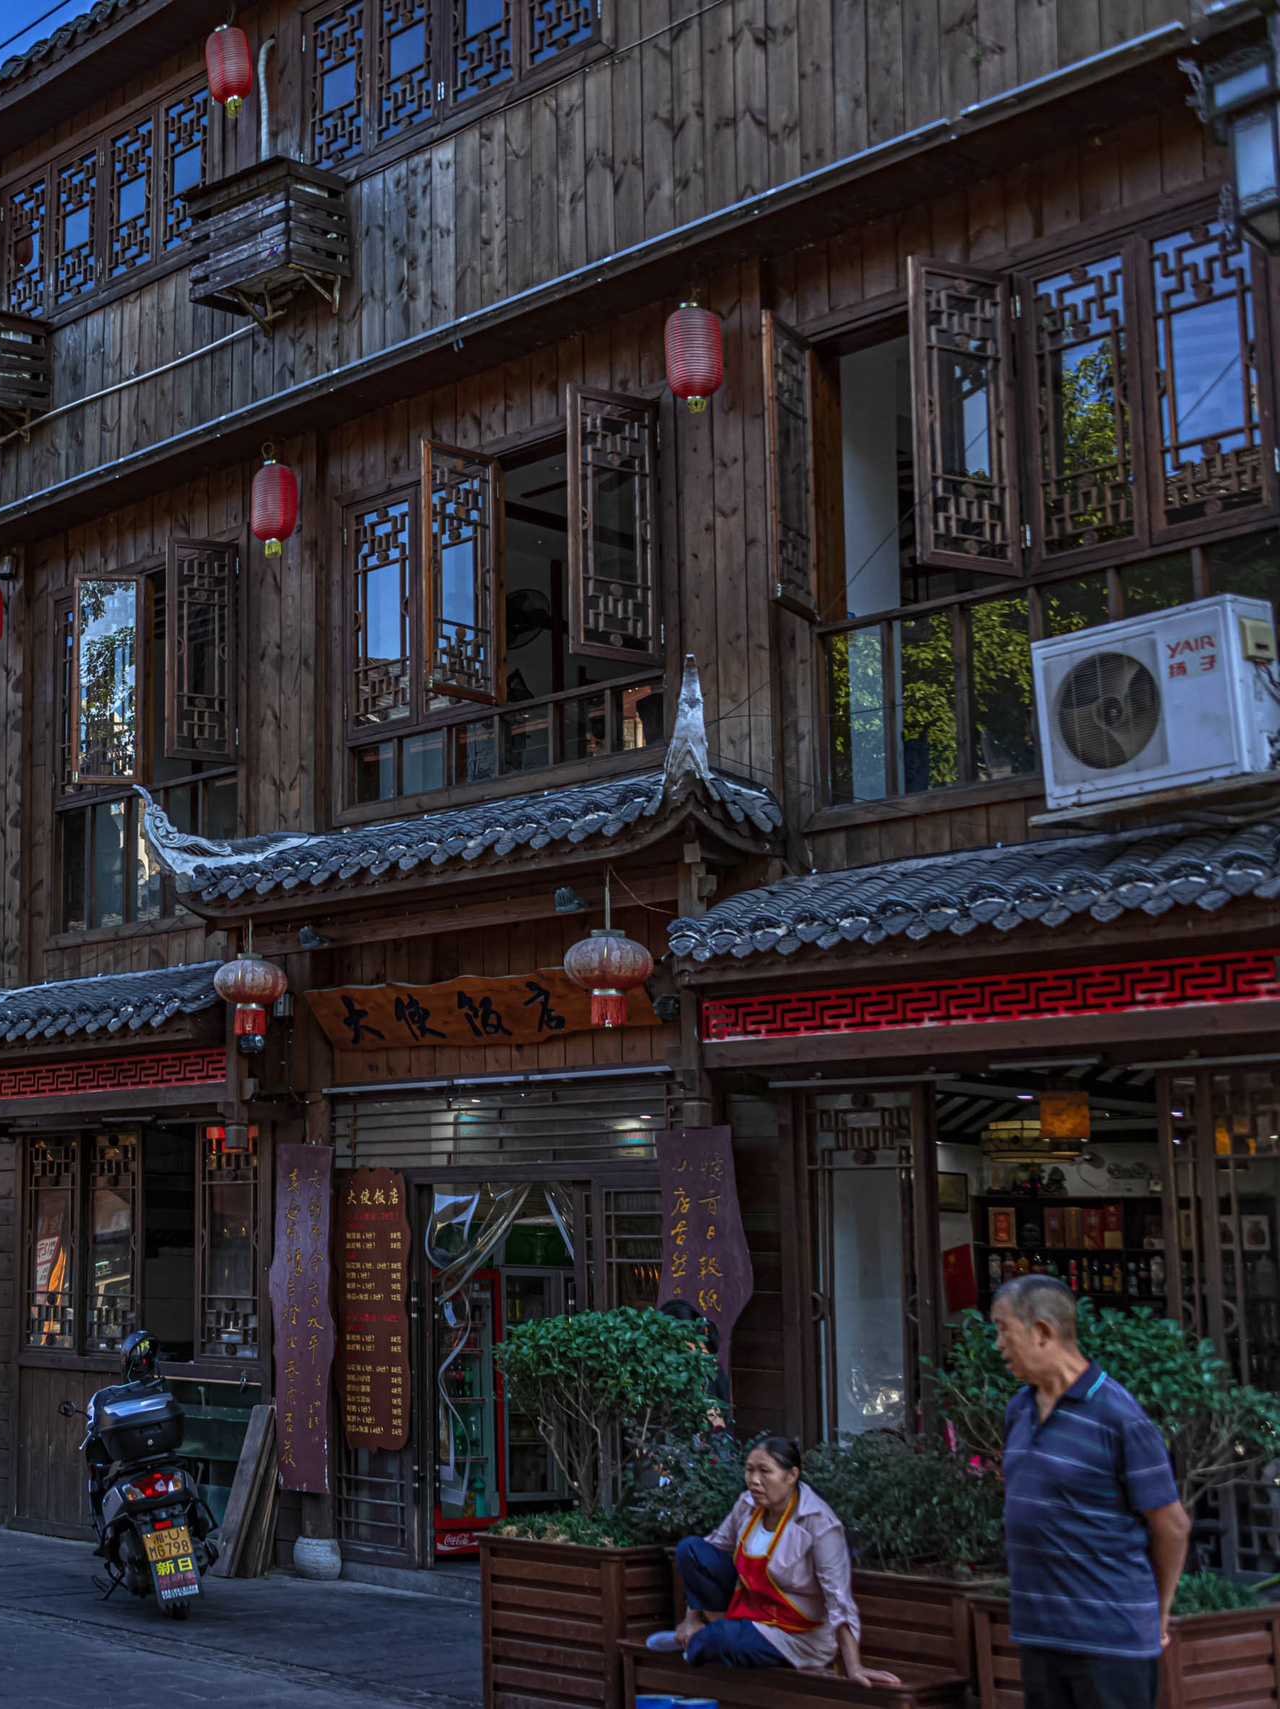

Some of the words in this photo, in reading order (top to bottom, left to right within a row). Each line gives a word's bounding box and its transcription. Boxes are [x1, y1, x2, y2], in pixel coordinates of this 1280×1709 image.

[1166, 635, 1215, 659] YAIR
[149, 1539, 190, 1560] MG798
[156, 1557, 193, 1576] 新日
